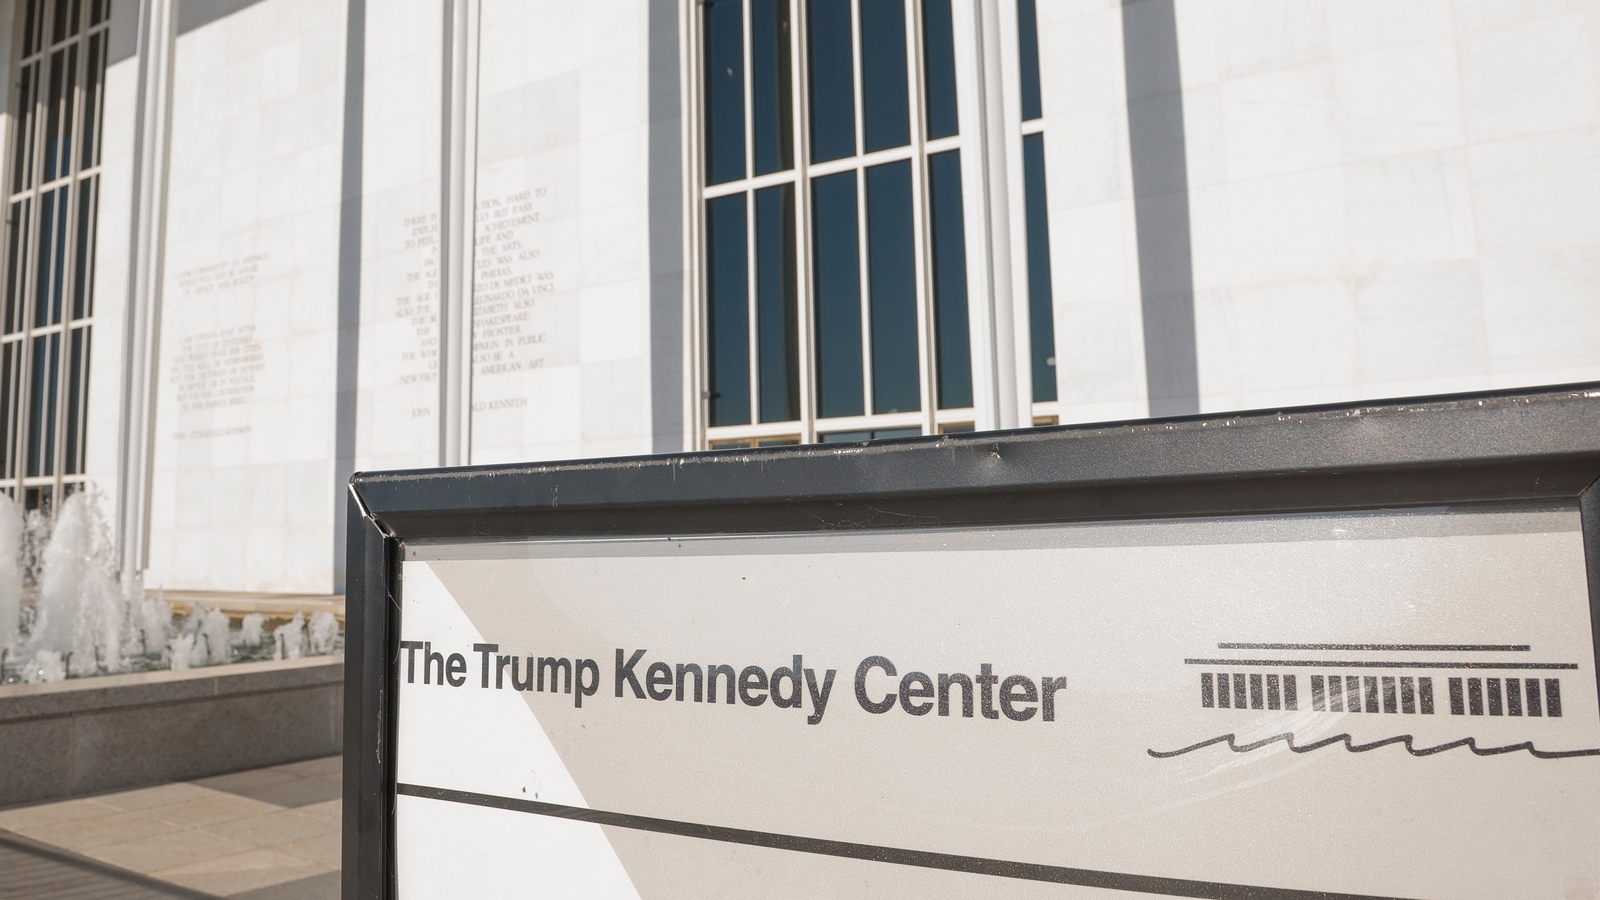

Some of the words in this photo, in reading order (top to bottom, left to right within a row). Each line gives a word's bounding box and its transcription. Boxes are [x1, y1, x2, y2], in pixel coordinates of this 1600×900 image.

[517, 332, 547, 346] PUBLIC
[480, 360, 522, 375] AMERICAN
[488, 397, 528, 411] KENNEDY
[401, 640, 467, 687] The
[473, 643, 599, 707] Trump
[614, 648, 836, 725] Kennedy
[854, 655, 1067, 722] Center
